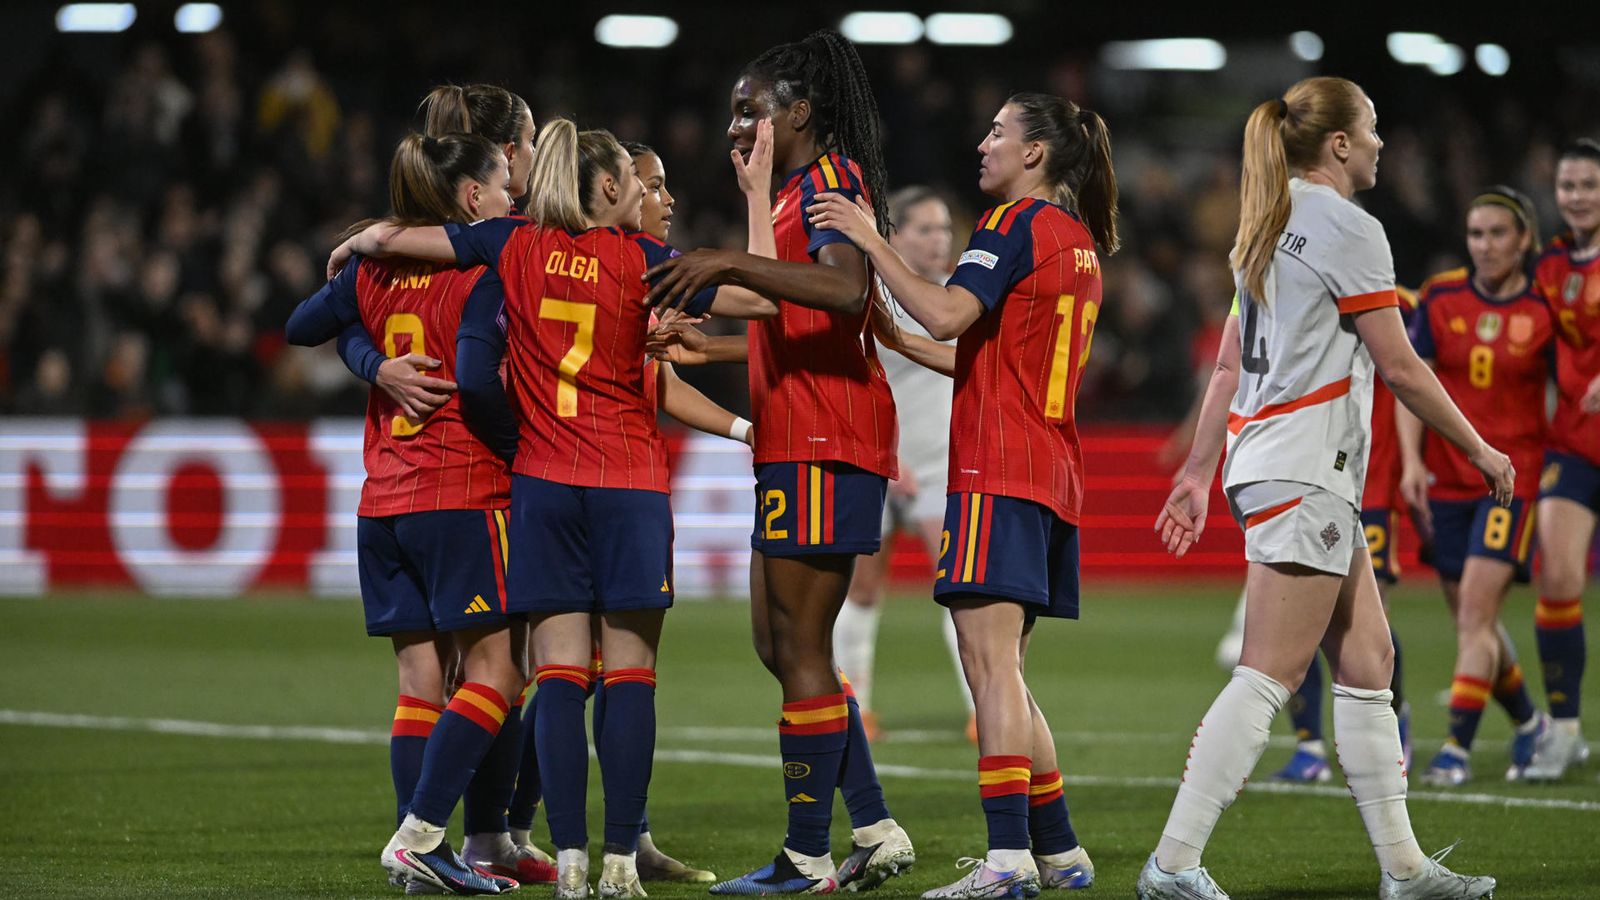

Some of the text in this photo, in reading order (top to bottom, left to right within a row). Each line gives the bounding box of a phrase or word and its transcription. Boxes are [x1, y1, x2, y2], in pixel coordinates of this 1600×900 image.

[545, 250, 599, 284] OLGA
[1073, 248, 1098, 277] PAT
[539, 297, 597, 417] 7
[1242, 289, 1270, 392] 4
[384, 312, 426, 437] 9
[1470, 345, 1495, 389] 8
[759, 489, 788, 540] 2
[1484, 505, 1513, 551] 8
